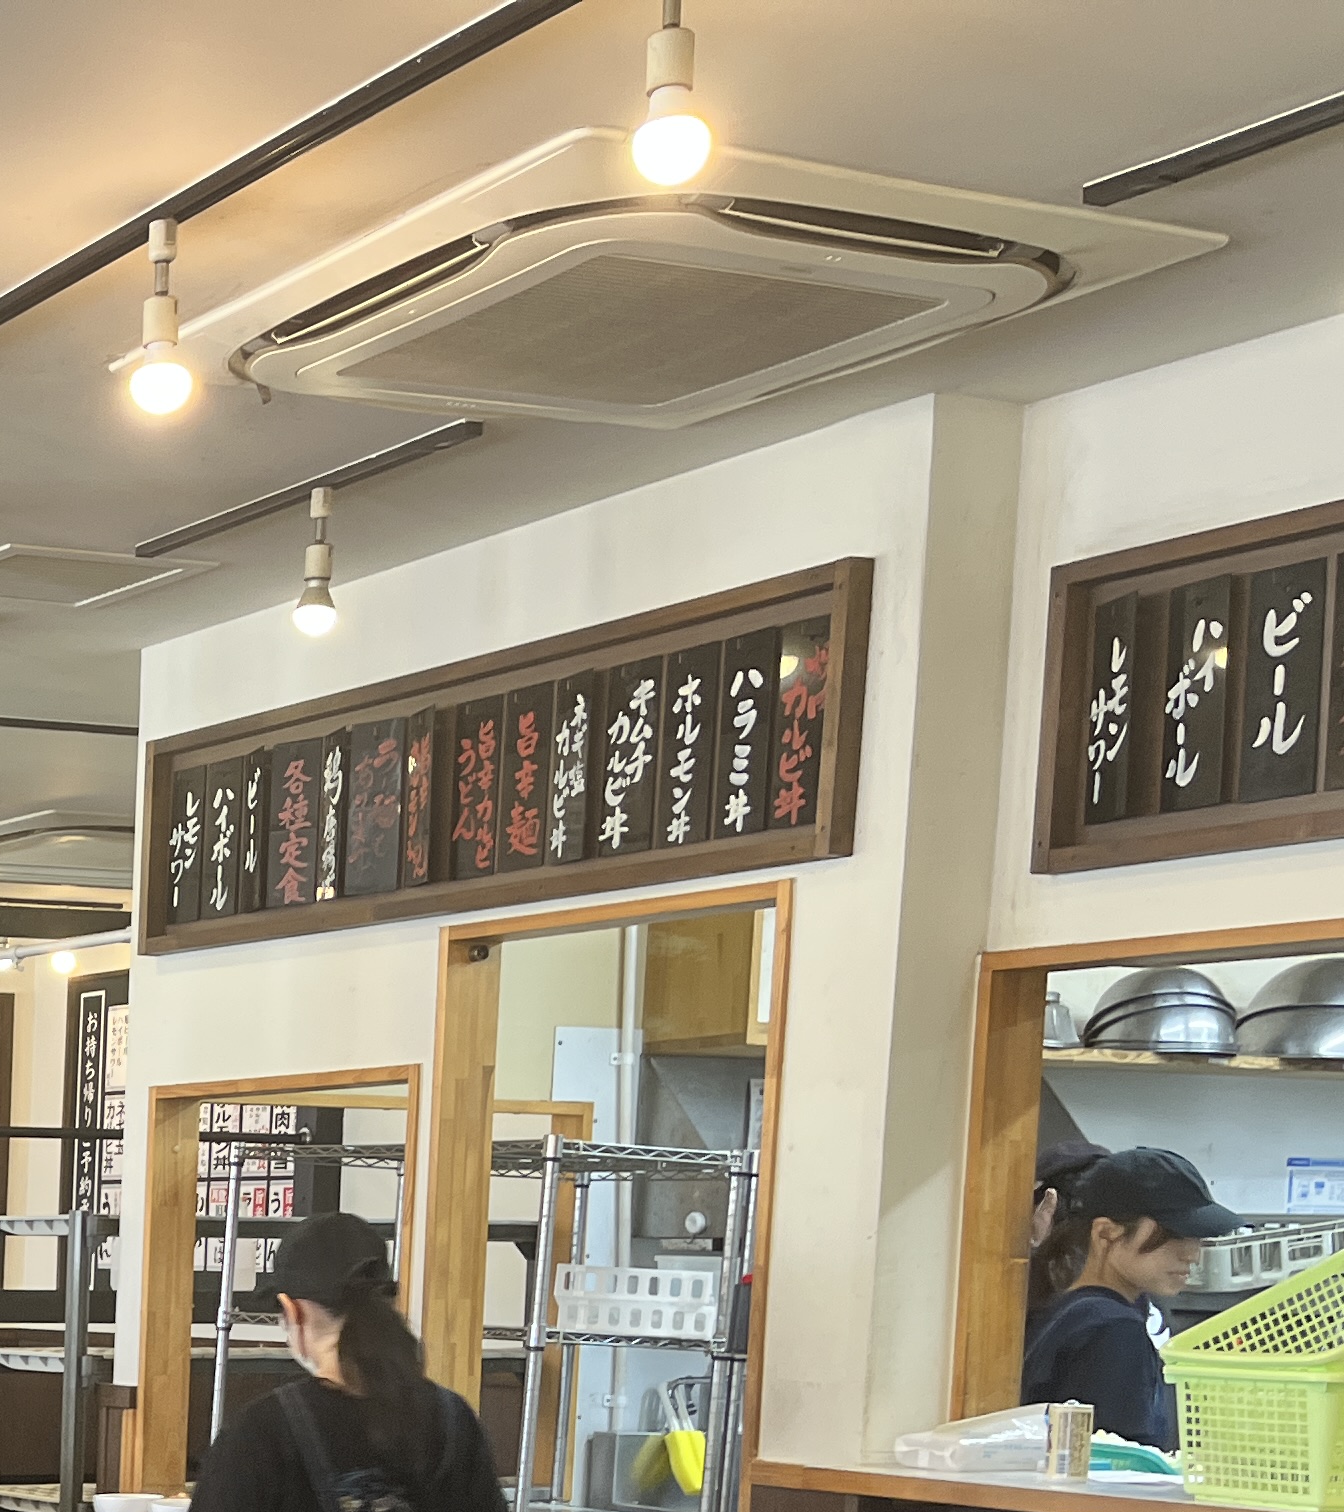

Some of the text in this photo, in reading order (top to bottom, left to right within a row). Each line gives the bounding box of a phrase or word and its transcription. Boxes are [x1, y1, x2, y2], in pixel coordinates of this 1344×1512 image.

[624, 679, 656, 784] キムチ
[1106, 637, 1129, 762] レモン
[1165, 618, 1223, 787] ハイボール
[1252, 591, 1312, 755] ビール
[453, 738, 476, 842] うどん
[476, 720, 496, 869] 旨辛カルビ
[506, 711, 540, 856] 旨辛麺
[550, 720, 570, 858] カルビ丼
[598, 711, 631, 850] カルビ丼
[667, 674, 702, 844] ホルモン丼
[723, 668, 764, 833] ハラミ丼
[774, 677, 812, 826] カルビ丼
[1088, 688, 1107, 804] サワー
[170, 823, 183, 907] サワー
[185, 792, 200, 869] レモン
[210, 788, 234, 911] ハイボール
[244, 767, 261, 873] ビール
[275, 759, 312, 904] 各種定食
[79, 1011, 98, 1211] お持ち帰り予約
